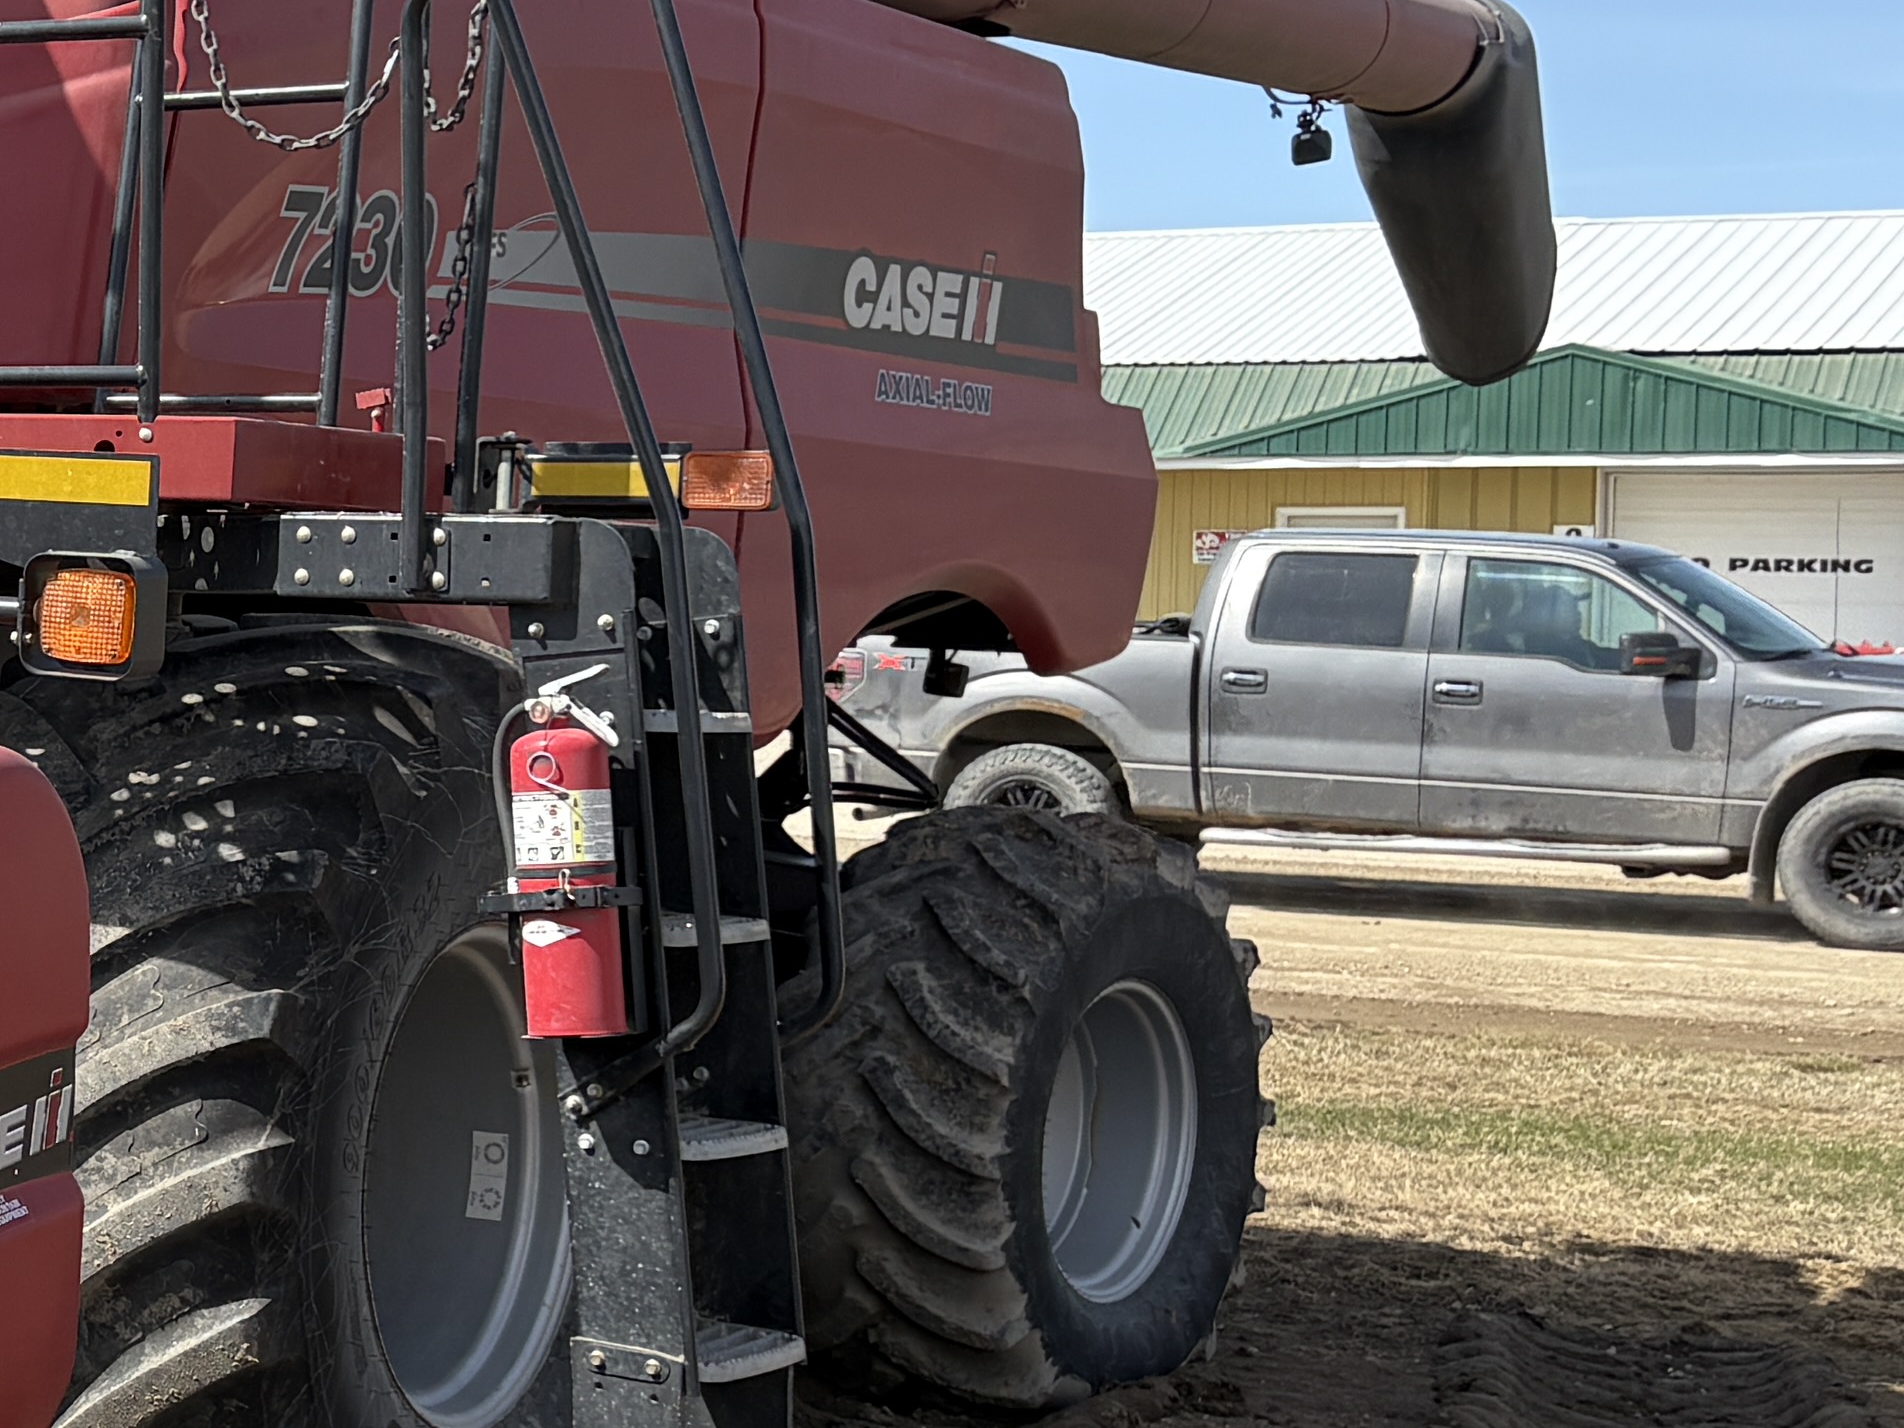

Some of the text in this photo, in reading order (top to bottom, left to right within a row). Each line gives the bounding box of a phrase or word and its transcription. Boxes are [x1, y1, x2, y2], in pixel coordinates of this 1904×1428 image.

[844, 256, 964, 346] CASE
[875, 369, 993, 416] AXIAL-FLOW
[1728, 557, 1874, 574] PARKING
